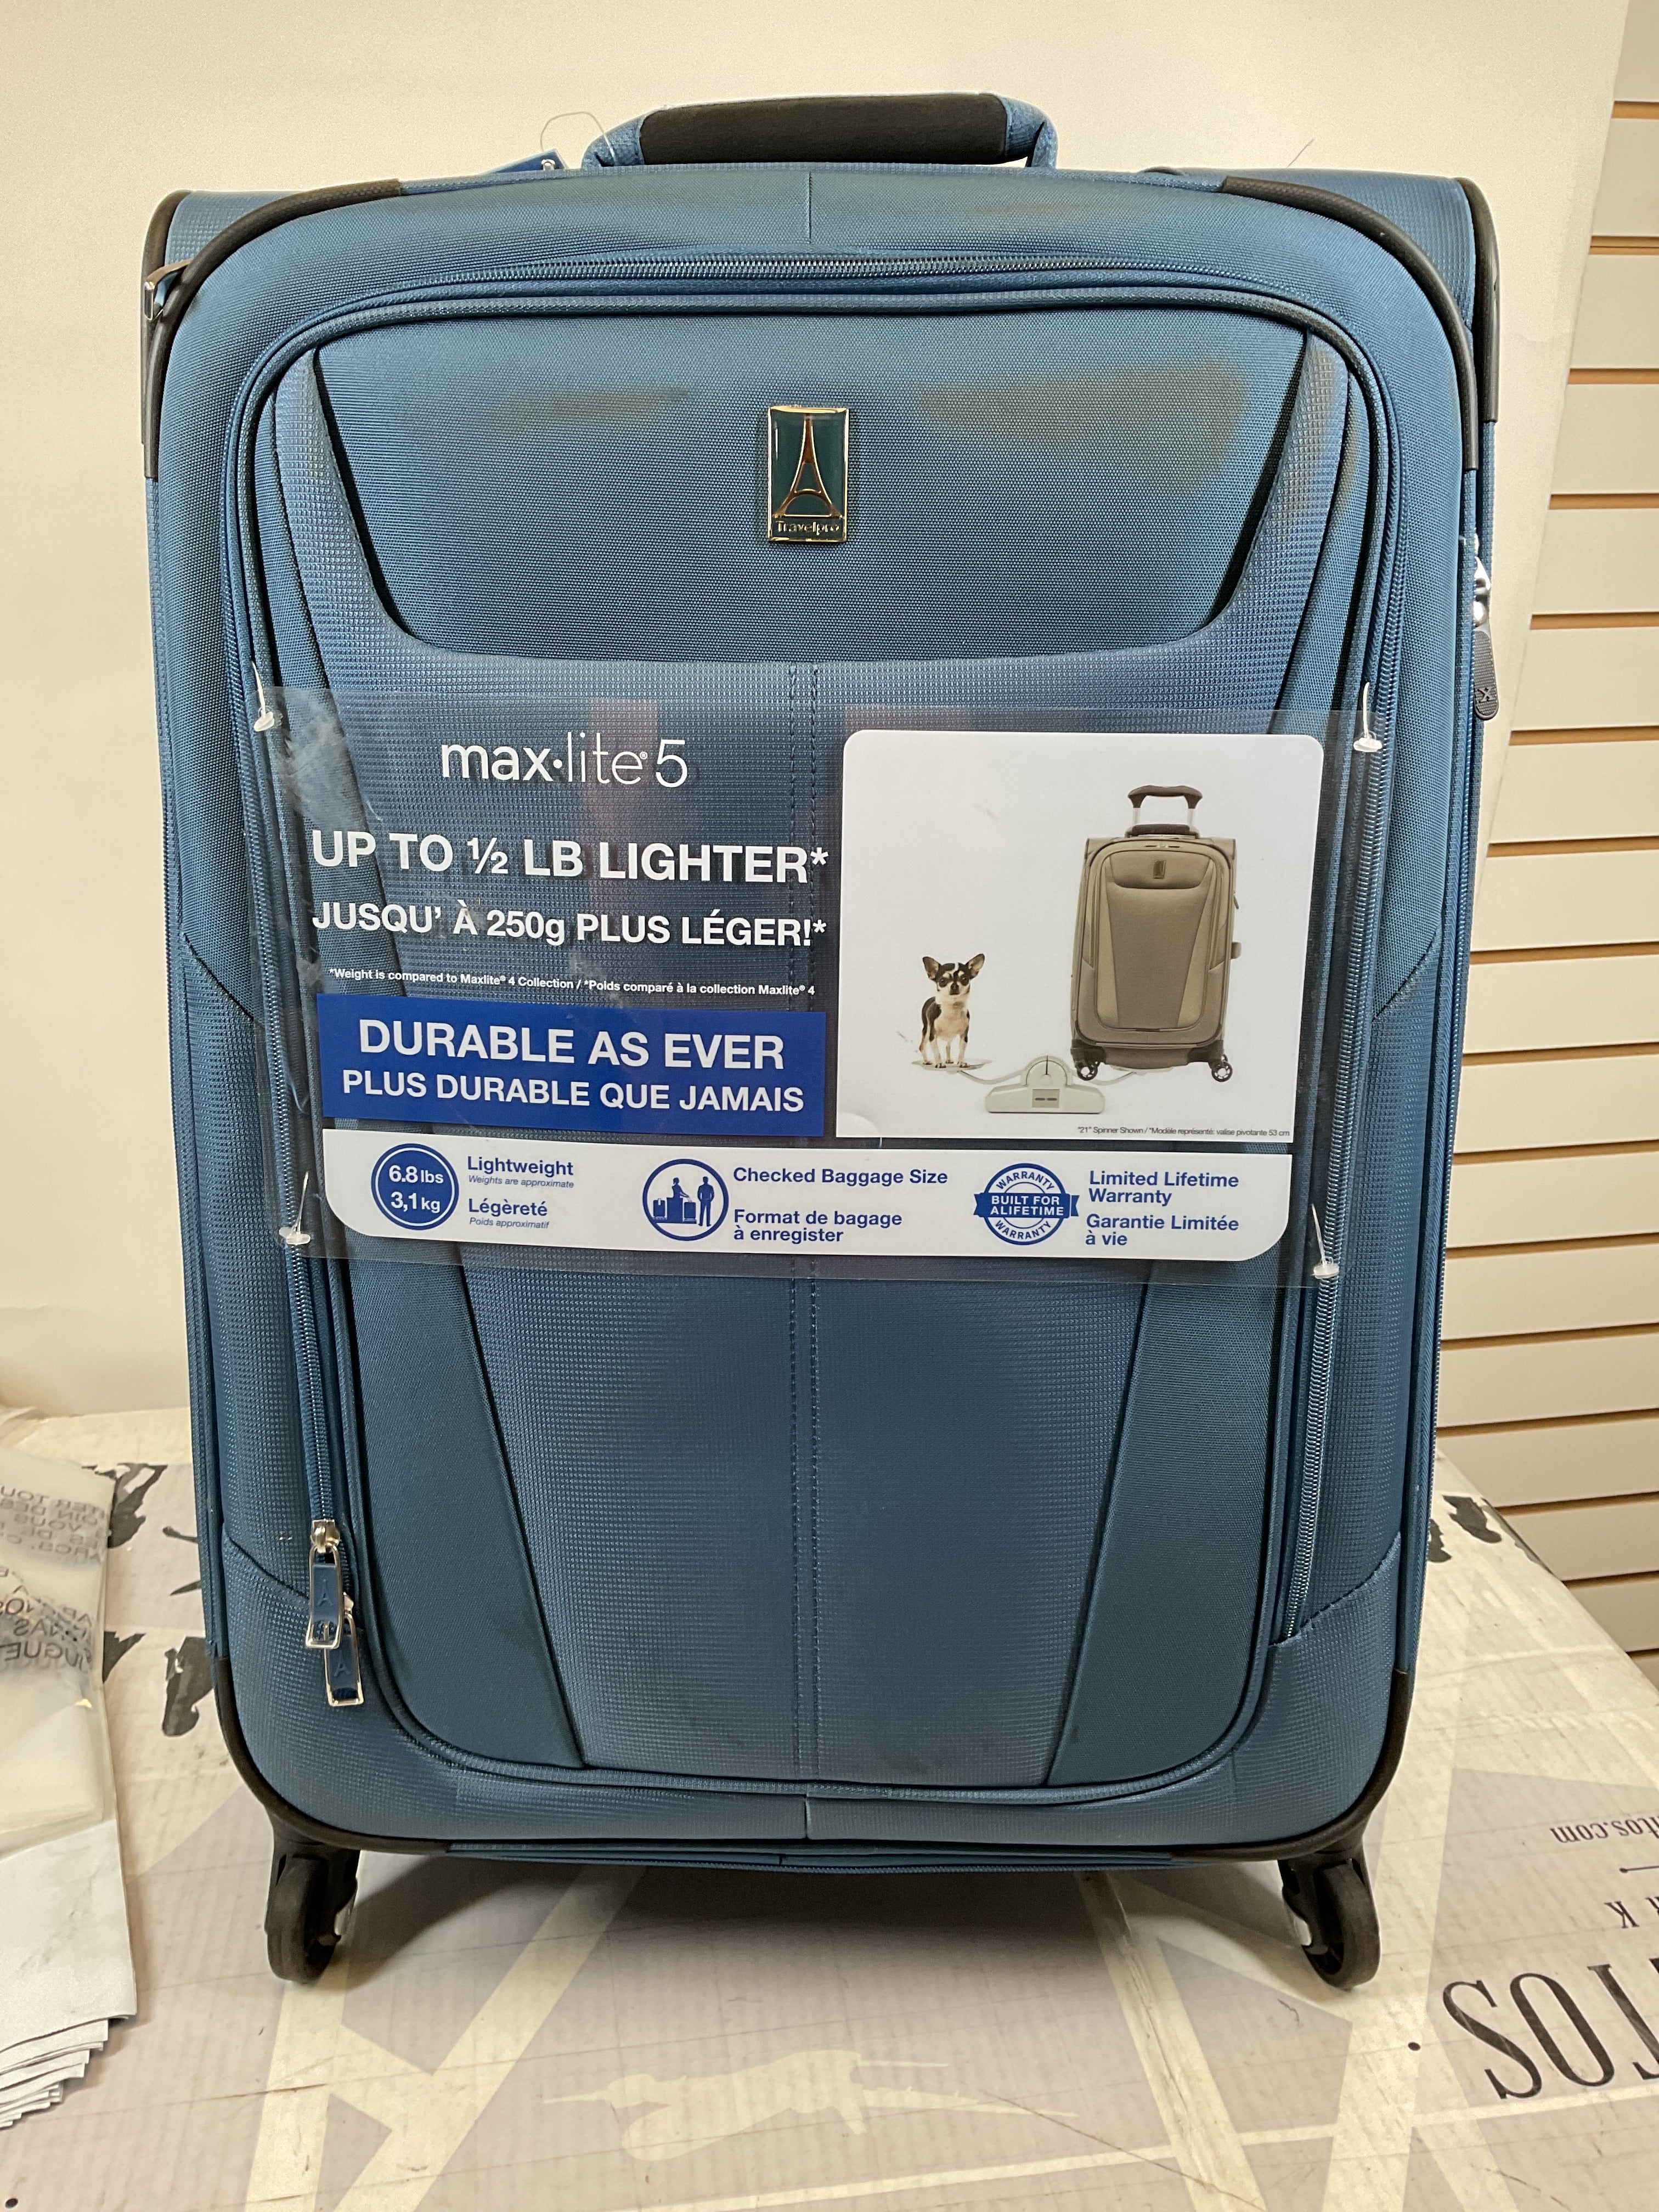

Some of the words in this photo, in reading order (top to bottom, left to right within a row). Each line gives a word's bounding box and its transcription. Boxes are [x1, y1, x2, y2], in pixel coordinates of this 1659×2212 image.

[656, 740, 687, 787] 5
[313, 830, 375, 867] UP
[389, 833, 453, 871] TO
[524, 839, 583, 876] LB
[453, 900, 477, 935] À
[487, 910, 564, 945] 250g
[577, 914, 669, 943] PLUS
[376, 970, 385, 979] is
[388, 973, 443, 983] compared
[446, 974, 457, 983] to
[509, 977, 515, 985] 4
[518, 977, 573, 988] Collection
[624, 983, 673, 994] comparé
[677, 983, 683, 992] à
[687, 984, 696, 992] la
[700, 984, 755, 994] collection
[808, 986, 815, 995] 4
[360, 1019, 574, 1063] DURABLE
[588, 1031, 648, 1066] AS
[665, 1034, 783, 1069] EVER
[343, 1070, 426, 1097] PLUS
[437, 1075, 589, 1105] DURABLE
[600, 1083, 669, 1109] QUE
[680, 1086, 803, 1111] JAMAIS
[390, 1165, 417, 1182] 6.8
[421, 1170, 443, 1183] lbs
[468, 1156, 573, 1176] Lightweight
[469, 1175, 502, 1185] Weights
[733, 1167, 815, 1182] Checked
[822, 1169, 903, 1186] Baggage
[910, 1169, 947, 1183] Size
[996, 1171, 1054, 1190] WARRANTY
[1090, 1171, 1158, 1186] Limited
[1165, 1172, 1238, 1187] Lifetime
[390, 1192, 417, 1212] 3,1
[422, 1198, 439, 1213] kg
[992, 1196, 1028, 1204] BUILT
[1034, 1197, 1059, 1205] FOR
[1089, 1188, 1172, 1206] Warranty
[469, 1198, 547, 1217] Légèreté
[470, 1217, 493, 1226] Poids
[496, 1218, 549, 1228] approximatif
[735, 1209, 800, 1223] Format
[806, 1211, 827, 1224] de
[834, 1211, 902, 1228] bagage
[1087, 1214, 1164, 1229] Garantie
[1172, 1215, 1239, 1231] Limitée
[734, 1225, 743, 1239] à
[751, 1228, 843, 1244] enregister
[995, 1220, 1051, 1240] WARRANTY
[1086, 1230, 1095, 1245] à
[1102, 1232, 1127, 1245] vie
[1442, 1958, 1659, 2100] TOS
